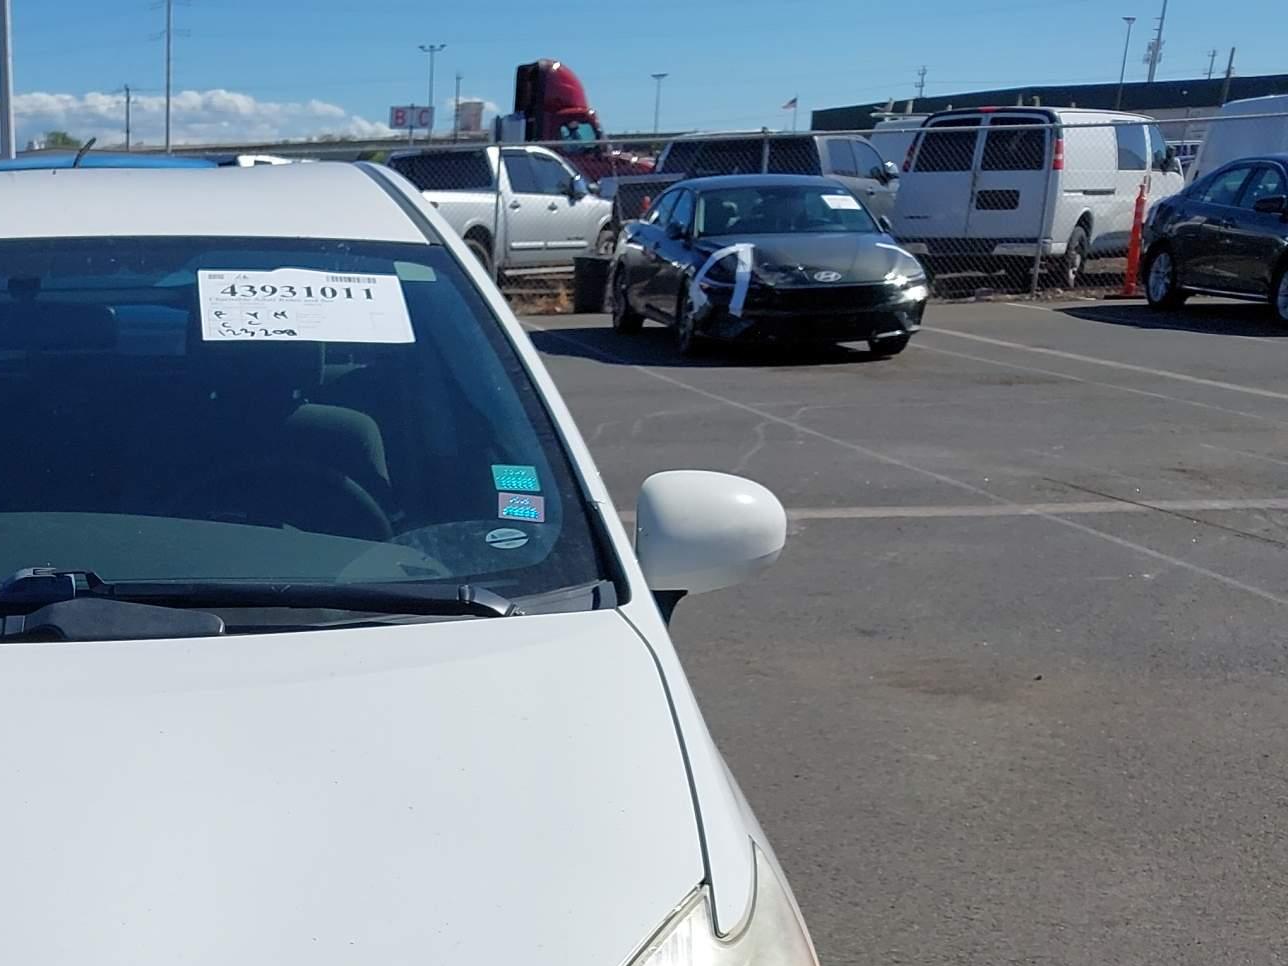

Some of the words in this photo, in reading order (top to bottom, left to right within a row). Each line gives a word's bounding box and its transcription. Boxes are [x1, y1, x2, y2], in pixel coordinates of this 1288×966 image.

[394, 109, 406, 127] B
[418, 109, 430, 127] C
[220, 283, 373, 301] 43931011
